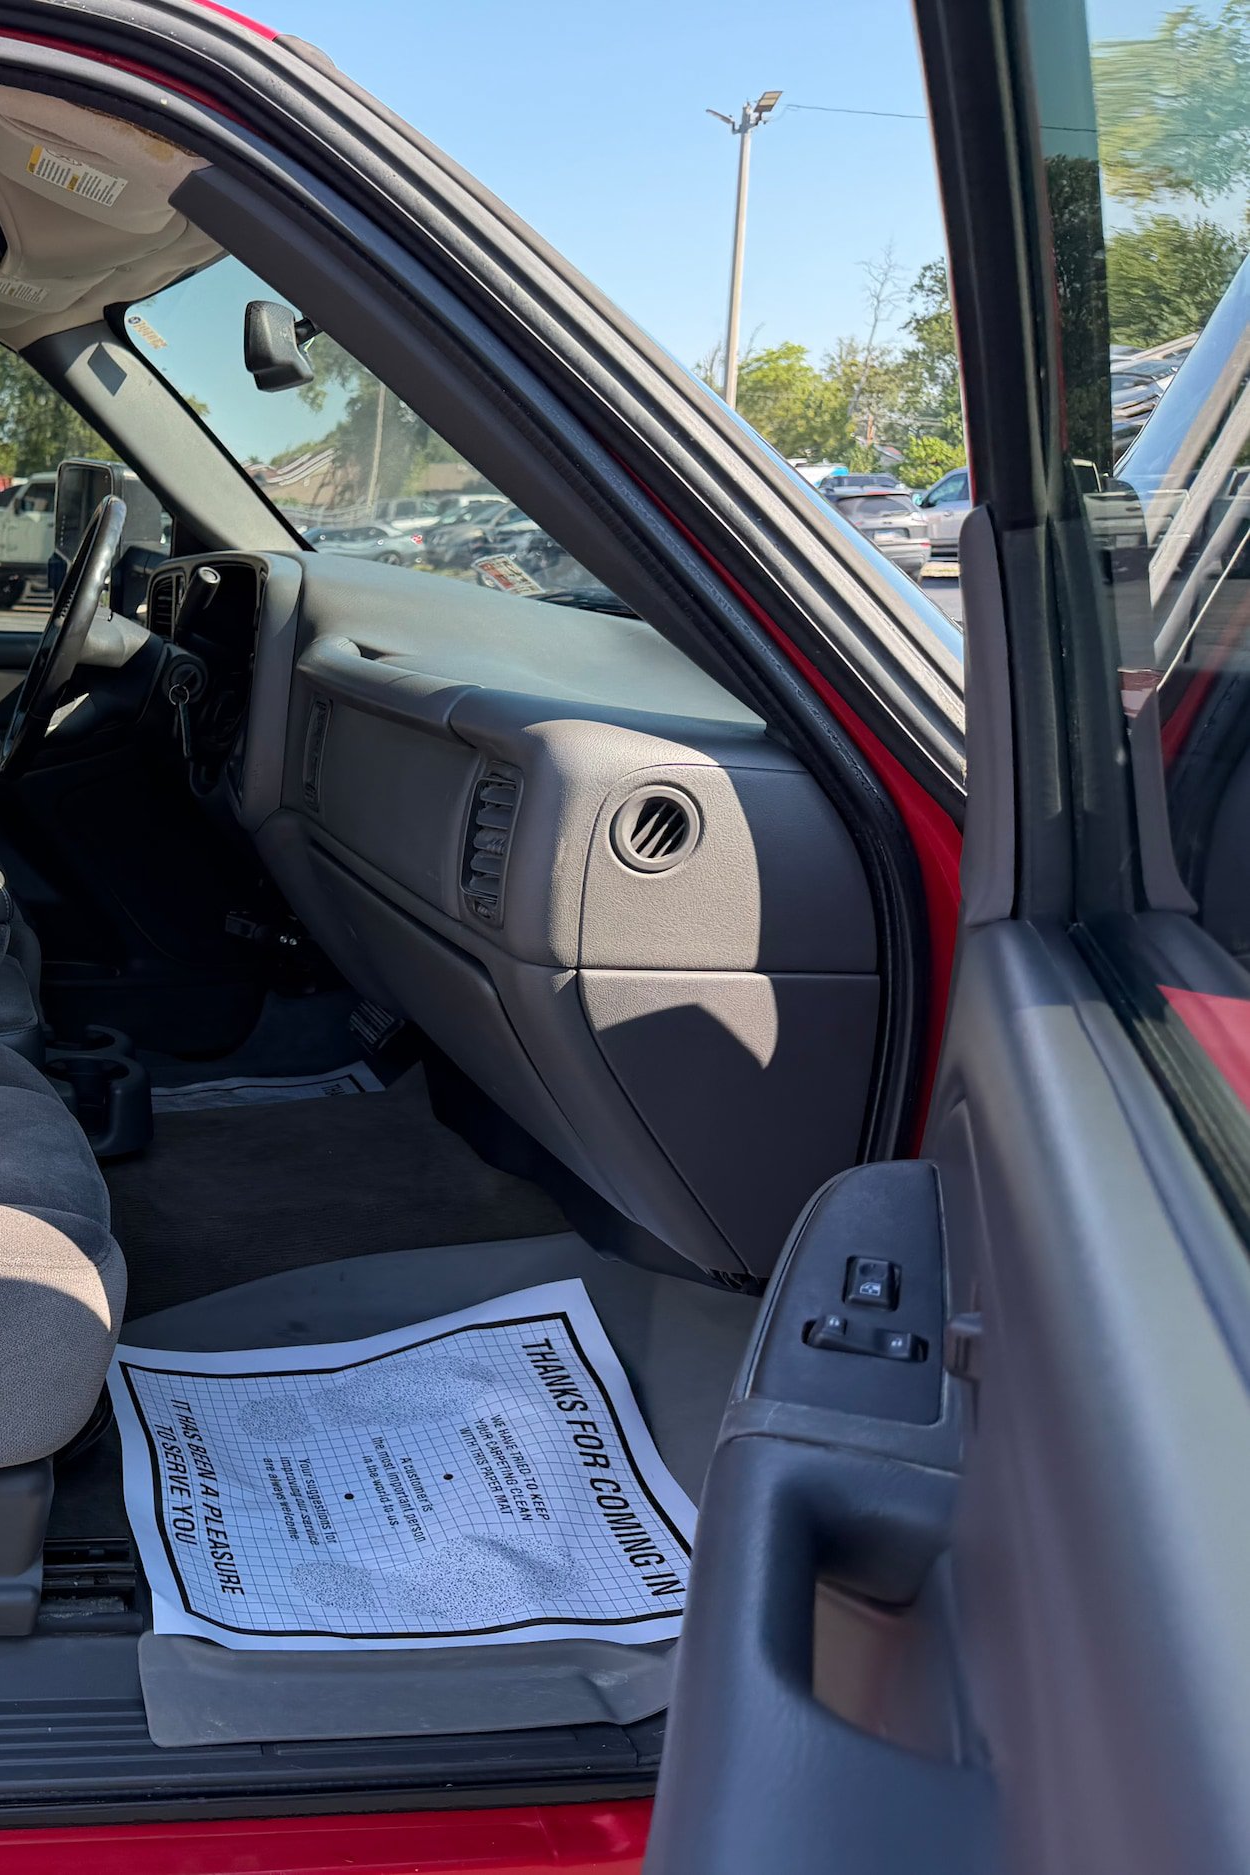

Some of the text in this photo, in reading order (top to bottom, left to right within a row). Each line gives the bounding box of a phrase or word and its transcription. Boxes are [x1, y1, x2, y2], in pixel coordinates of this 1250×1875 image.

[154, 1424, 197, 1545] TO SERVE YOU
[171, 1399, 245, 1595] IT HAS BEEN A PLEASURE
[264, 1457, 275, 1471] are
[268, 1473, 286, 1500] always
[280, 1457, 319, 1546] improving our service
[299, 1458, 337, 1543] Your suggestions for
[362, 1455, 373, 1463] in
[366, 1464, 378, 1477] the
[372, 1436, 426, 1542] the most important person
[373, 1479, 392, 1503] world
[404, 1464, 431, 1502] customer
[422, 1504, 433, 1512] is
[459, 1427, 513, 1515] WITH THIS PAPER MAT
[474, 1418, 533, 1521] YOUR CARPETING CLEAN
[491, 1415, 550, 1520] WE HAVE TRIED TO KEEP
[522, 1338, 686, 1596] THANKS FOR COMING IN
[383, 1504, 394, 1512] to
